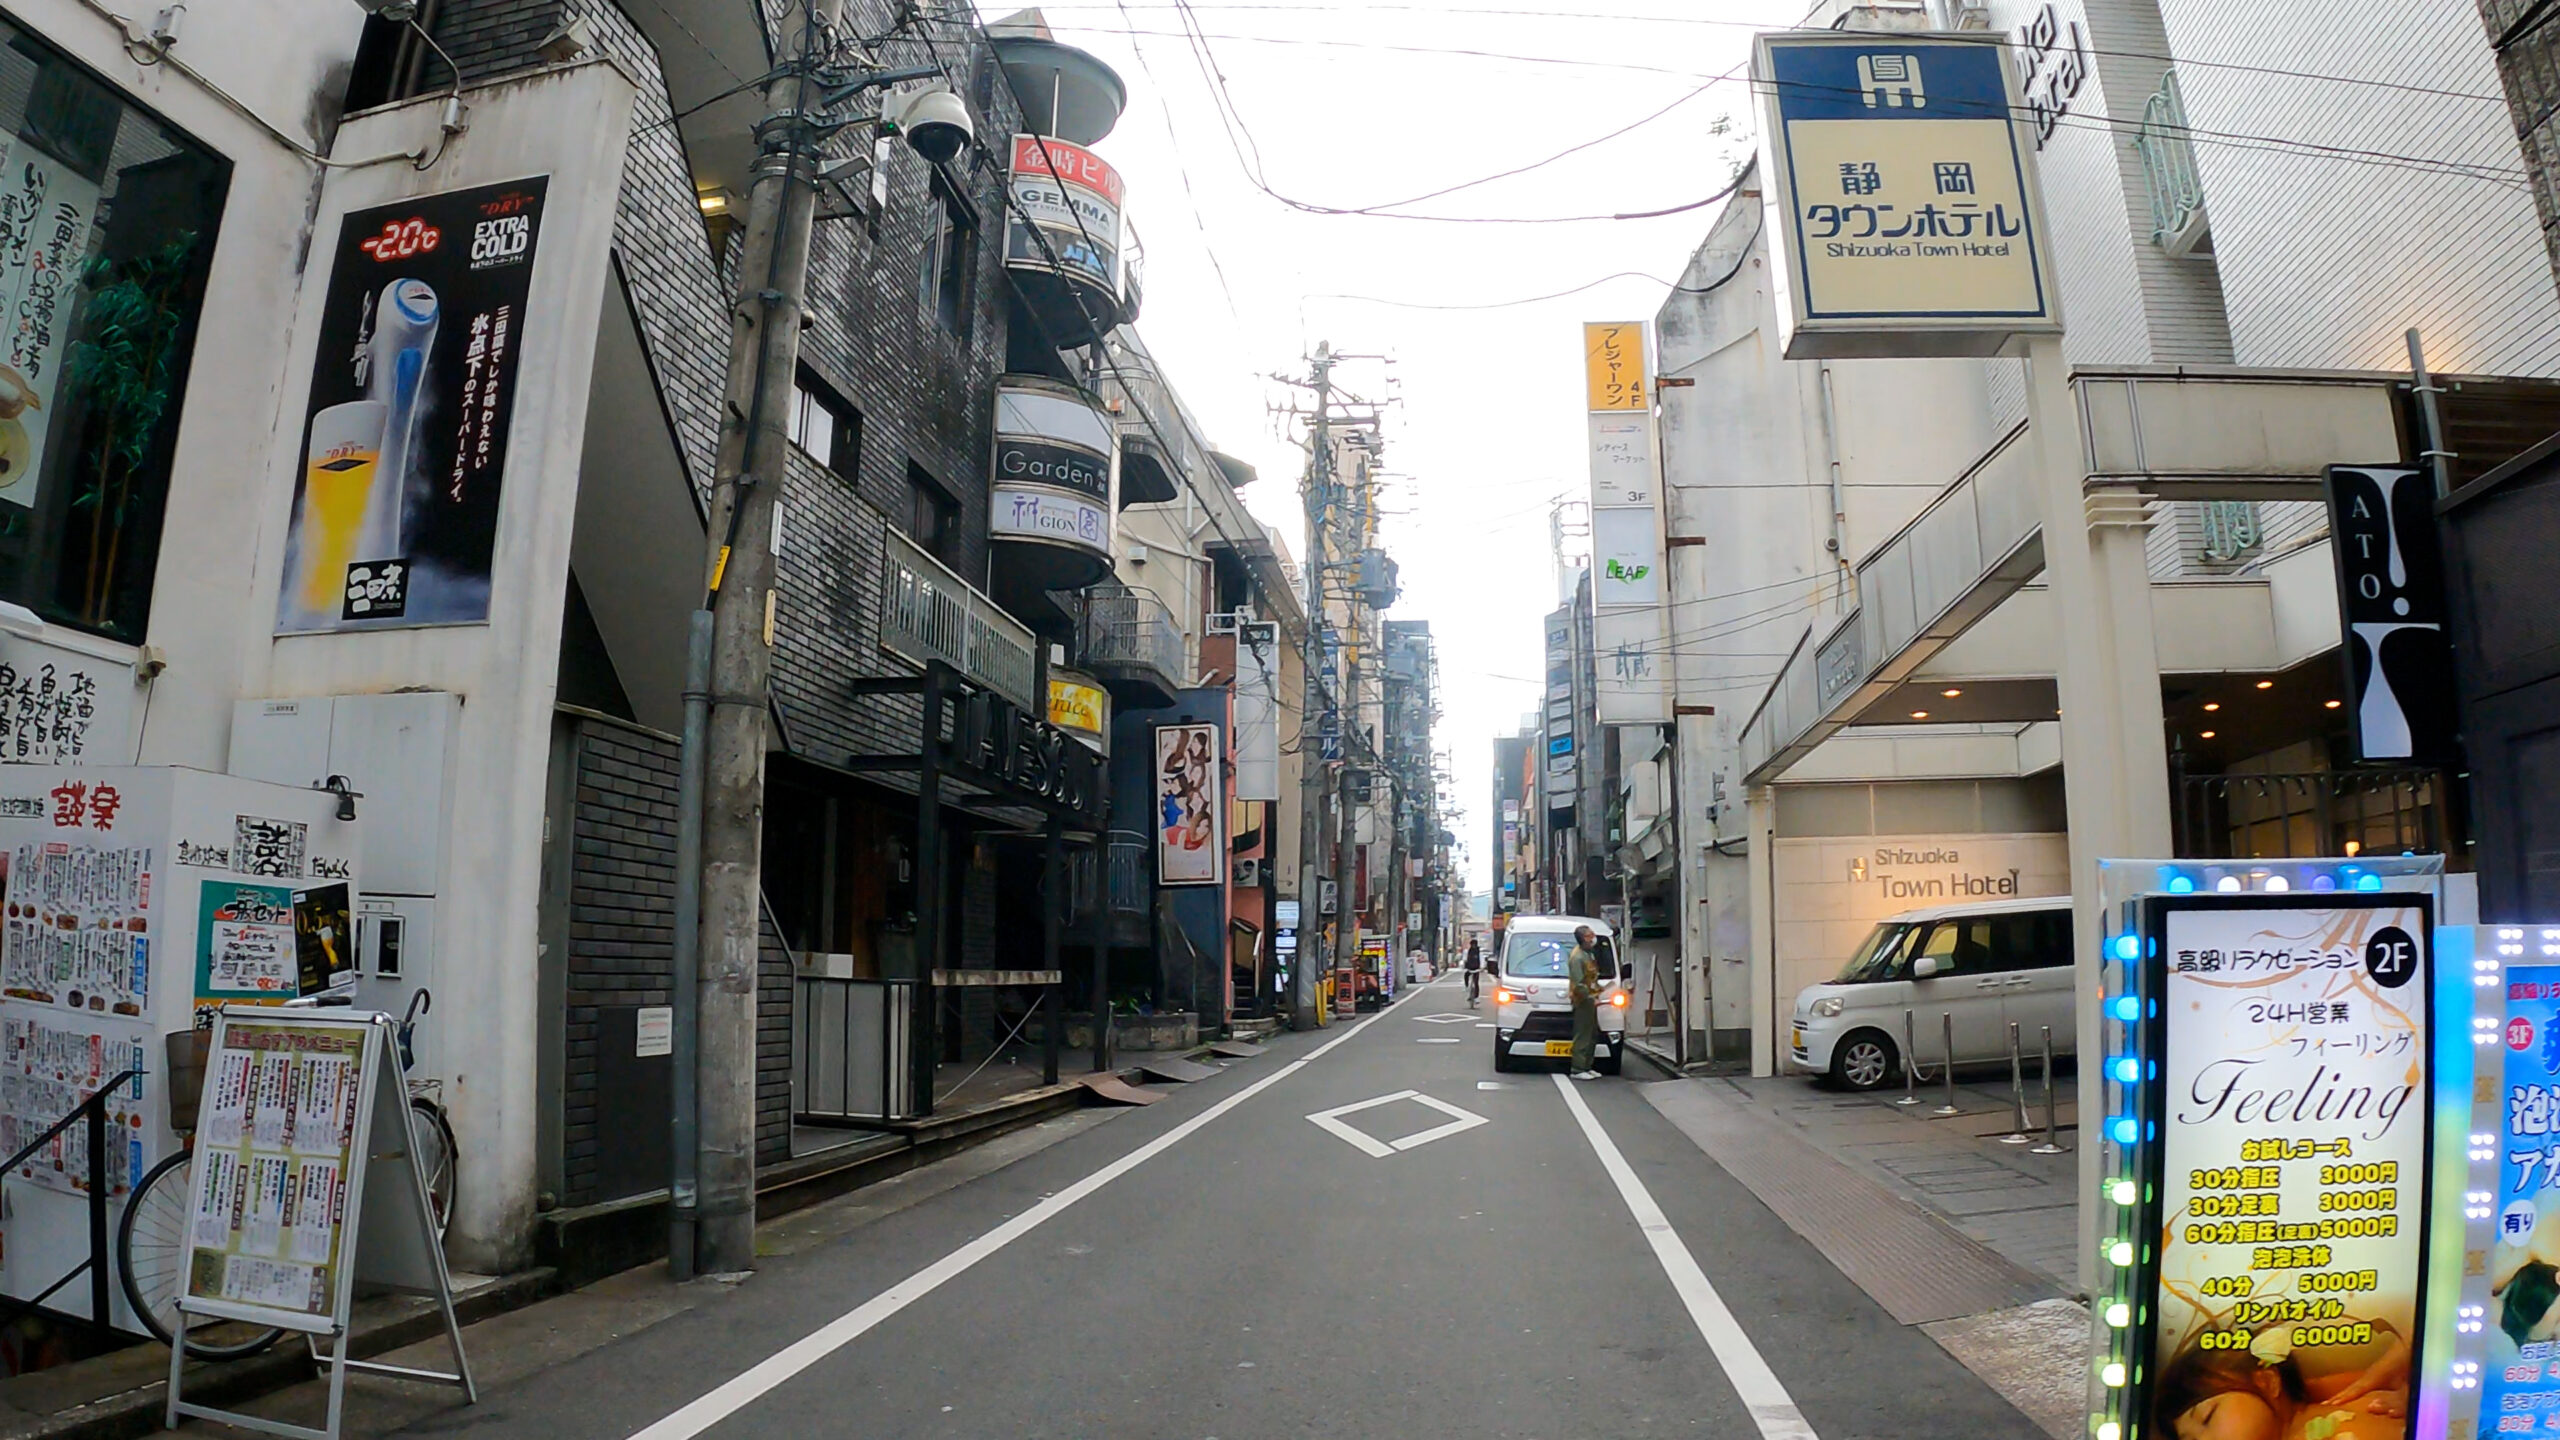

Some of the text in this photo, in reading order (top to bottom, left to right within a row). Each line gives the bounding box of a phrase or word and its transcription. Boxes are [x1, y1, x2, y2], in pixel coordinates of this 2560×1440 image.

[1024, 144, 1117, 194] 金時ビル
[1021, 189, 1111, 227] GEMMA
[1807, 203, 2021, 238] タウンホテル
[474, 214, 529, 239] EXTRA
[471, 231, 528, 261] COLD
[1826, 242, 2010, 258] Shizuoka Town Hotel
[1003, 450, 1094, 488] Garden
[1627, 491, 1648, 502] 3F
[1040, 516, 1077, 533] GION
[2351, 495, 2382, 600] ATO
[1605, 565, 1647, 580] LEAF
[1875, 848, 1959, 866] Shizuoka
[1876, 869, 2019, 899] Town Hotel
[2177, 948, 2361, 973] 高級リラクゼーション
[2374, 943, 2409, 974] 2F
[2249, 1001, 2351, 1025] 24H営業
[2290, 1031, 2416, 1058] フィーリング
[2507, 1023, 2532, 1046] 3F
[2177, 1057, 2418, 1142] Feeling
[2240, 1138, 2353, 1162] お試しコース
[2188, 1161, 2399, 1190] 30分指圧 3000円
[2187, 1188, 2398, 1217] 30分足裏 3000円
[2318, 1215, 2398, 1239] 5000円
[2251, 1246, 2332, 1270] 泡泡洗体
[2200, 1270, 2378, 1298] 40分 5000円
[2232, 1299, 2344, 1324] リンパオイル
[2198, 1323, 2372, 1352] 60分 6000円
[2504, 1367, 2541, 1382] 60分
